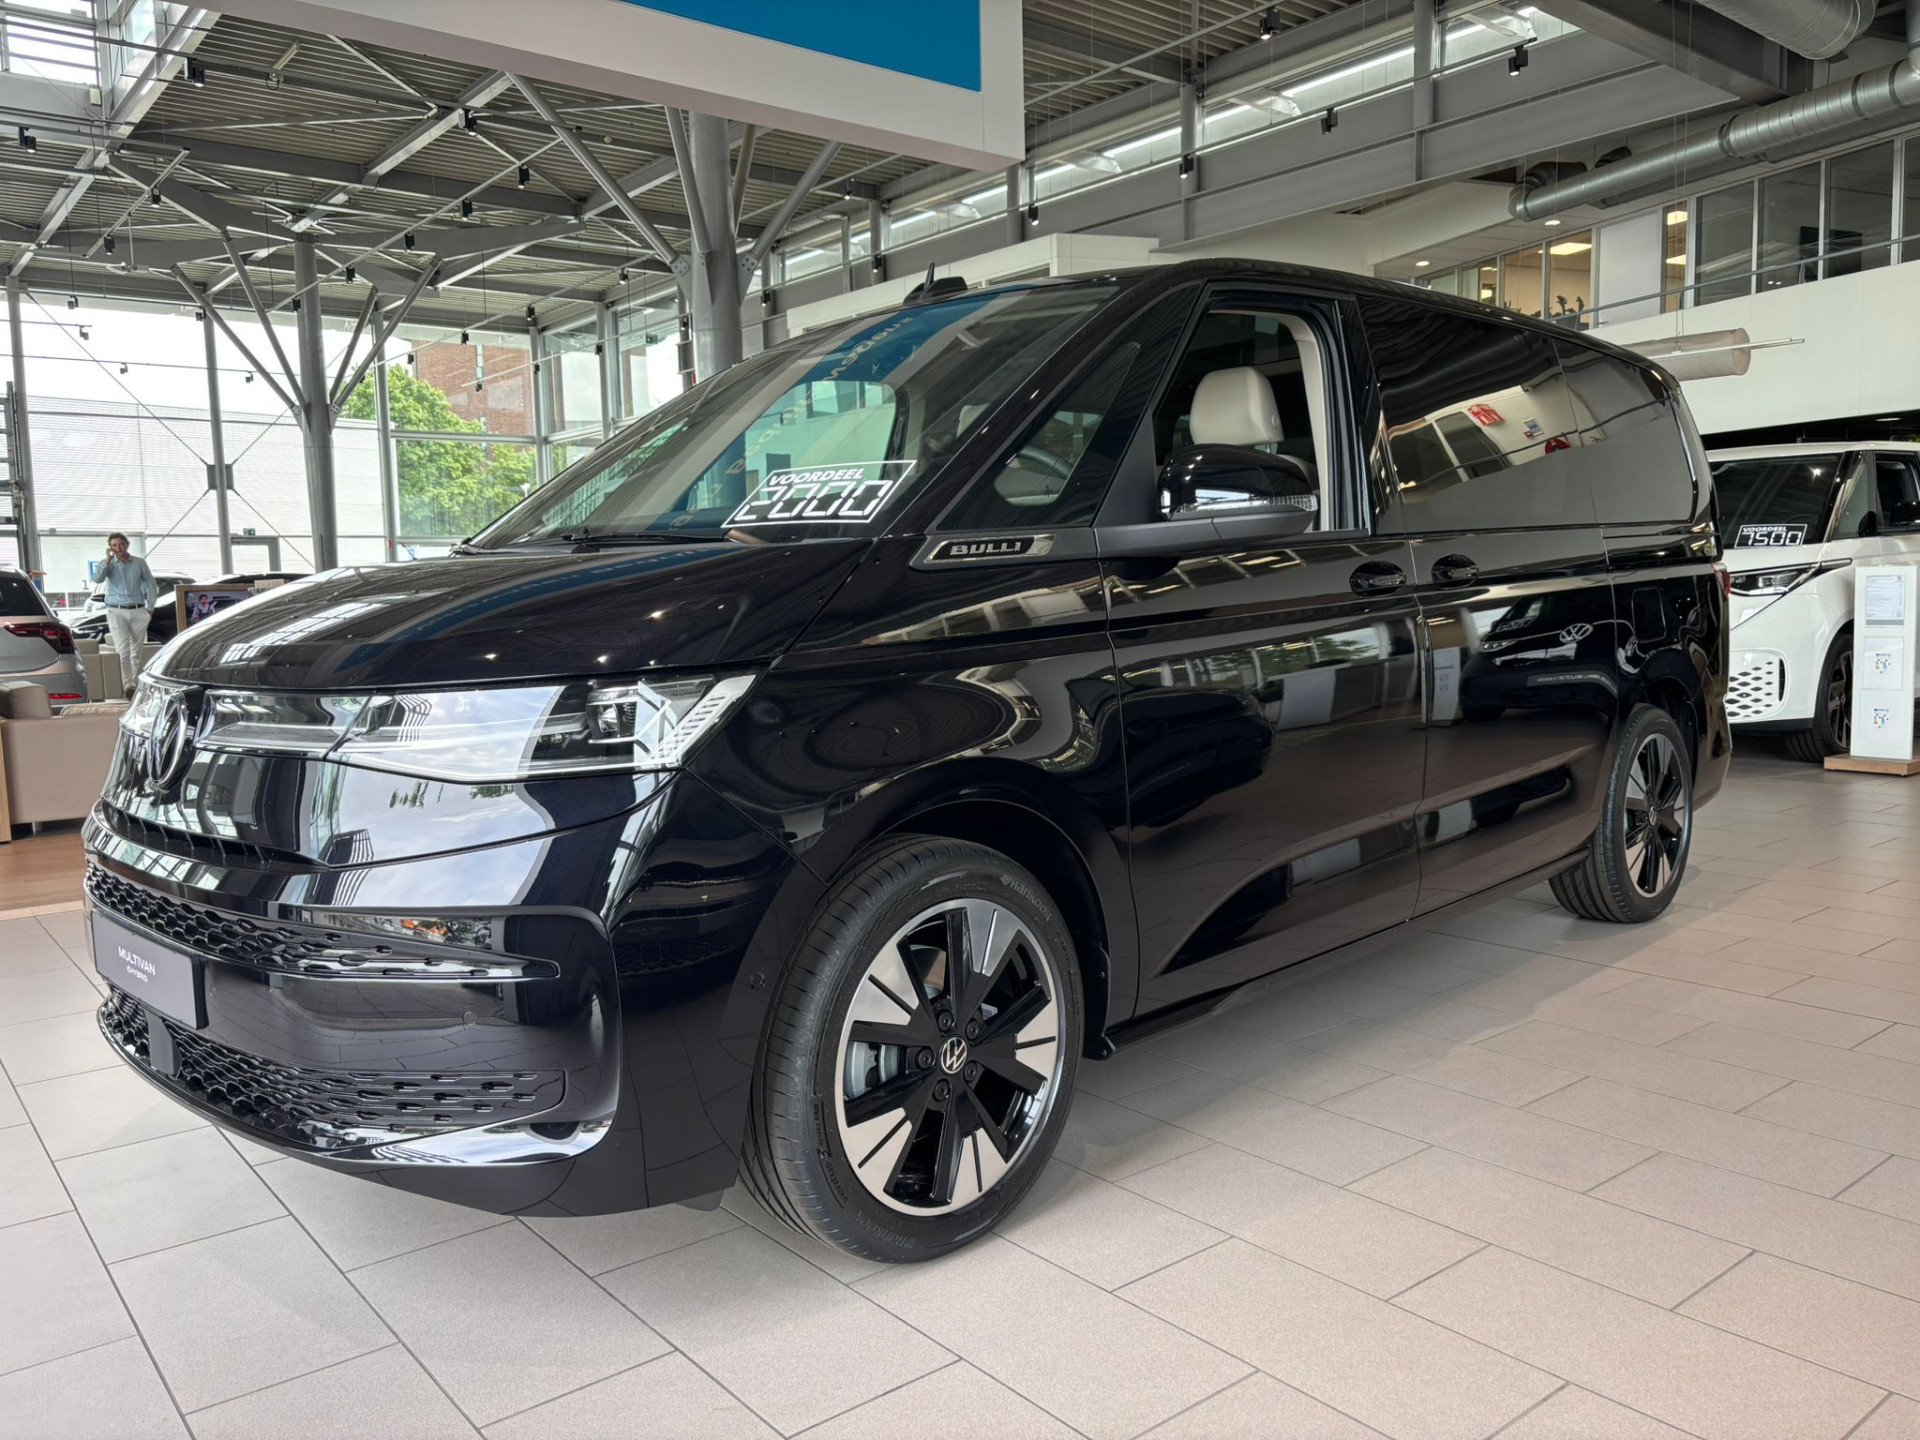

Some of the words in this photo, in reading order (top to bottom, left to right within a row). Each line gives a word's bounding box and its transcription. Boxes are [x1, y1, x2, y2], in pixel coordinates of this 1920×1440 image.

[769, 468, 865, 486] VOORDEEL
[734, 480, 893, 521] 2000
[1741, 531, 1802, 546] 7500
[949, 541, 1021, 556] BULLI
[118, 945, 157, 977] MULTIVAN
